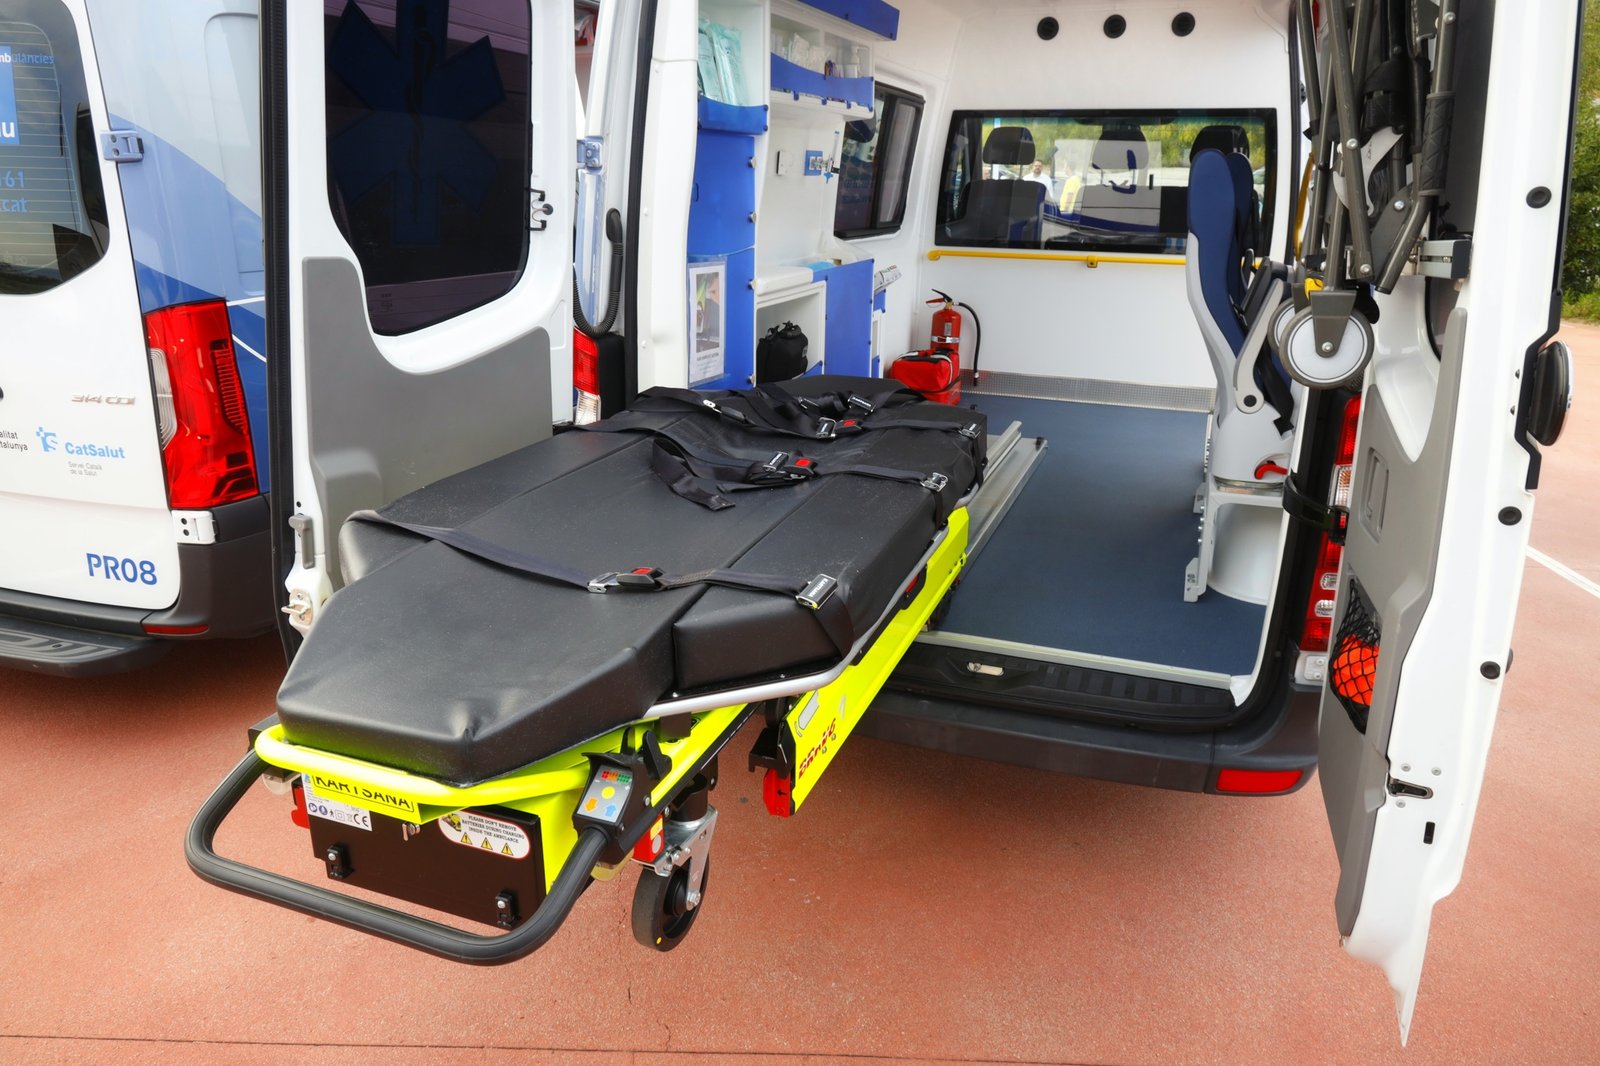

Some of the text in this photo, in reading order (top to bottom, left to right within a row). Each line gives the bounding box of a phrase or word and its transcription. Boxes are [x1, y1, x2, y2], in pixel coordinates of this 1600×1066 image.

[71, 394, 136, 405] 314 CDI
[65, 442, 126, 458] CatSalut
[86, 553, 158, 585] PR08
[468, 815, 484, 823] PLEASE
[499, 822, 517, 832] REMOVE
[493, 833, 519, 844] AMBULANCE
